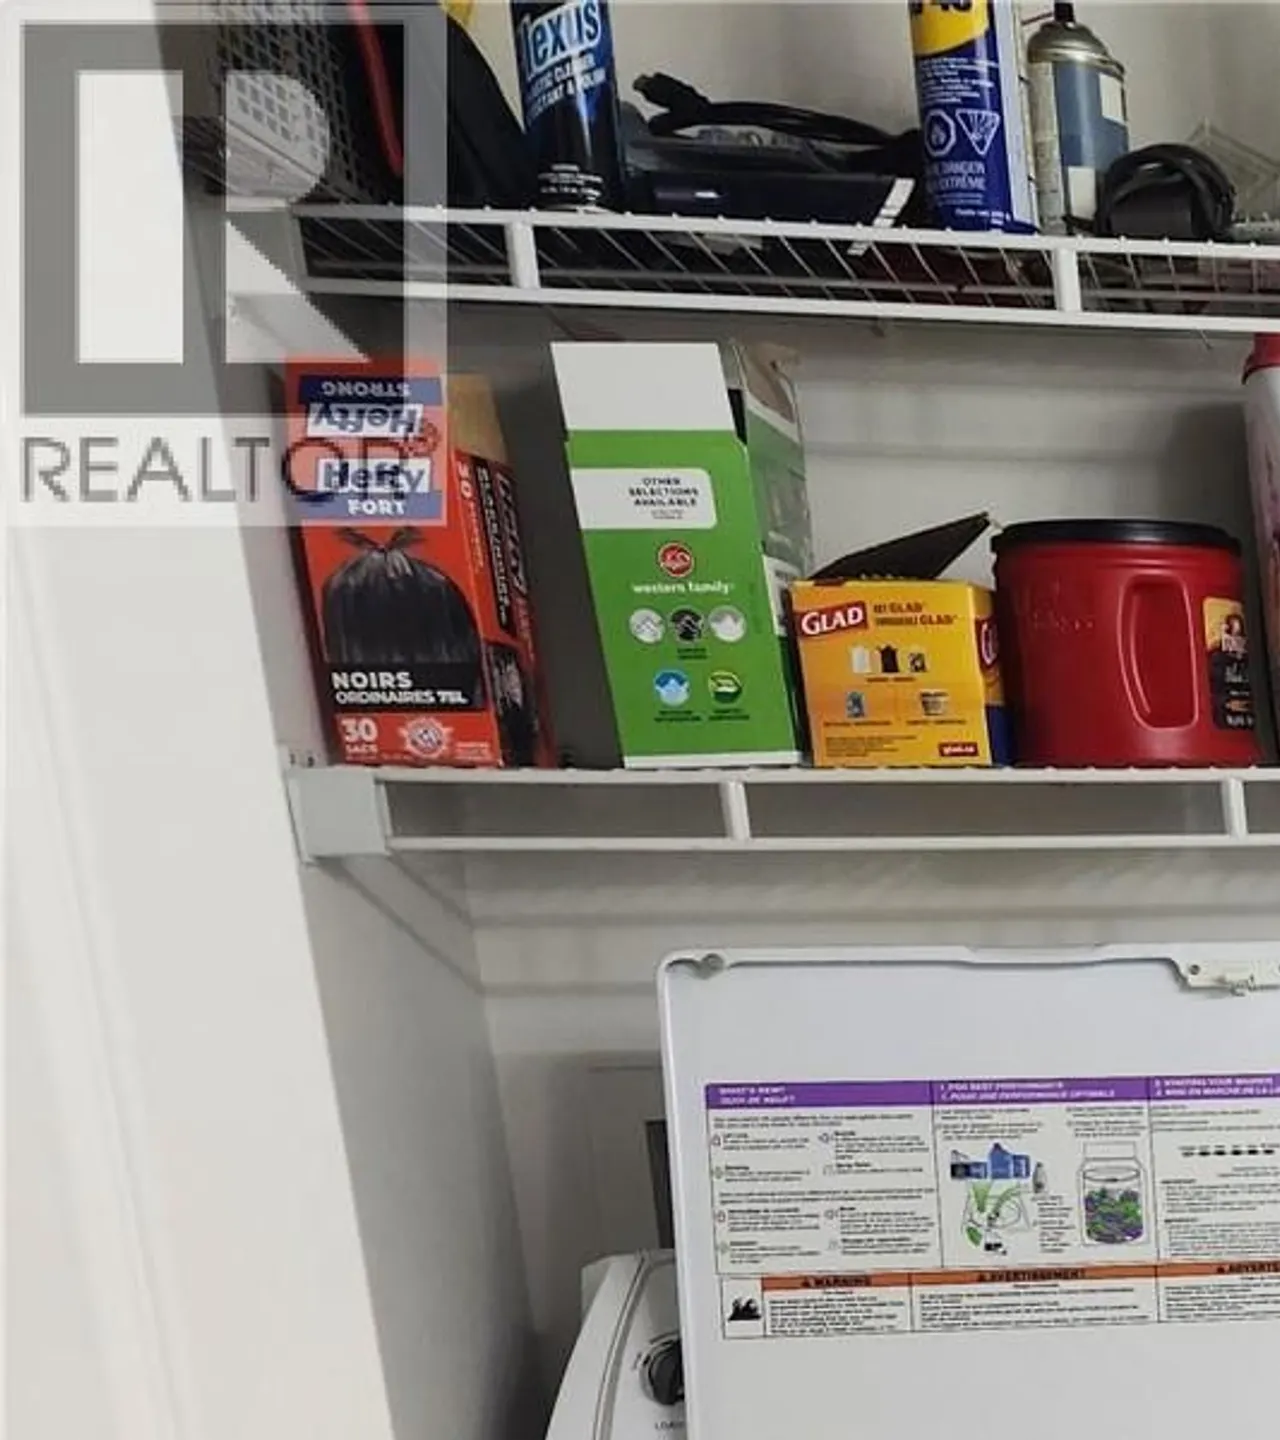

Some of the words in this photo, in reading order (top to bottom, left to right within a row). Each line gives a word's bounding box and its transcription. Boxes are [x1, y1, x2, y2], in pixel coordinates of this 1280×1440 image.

[321, 380, 412, 398] STRONG
[311, 405, 419, 433] Hefty
[322, 461, 426, 494] Hefty
[347, 499, 406, 516] FORT
[631, 582, 686, 595] western
[688, 580, 731, 595] family
[800, 605, 865, 636] GLAD
[330, 671, 413, 690] NOIRS
[335, 690, 435, 704] ORDINAIRES
[340, 717, 379, 742] 30
